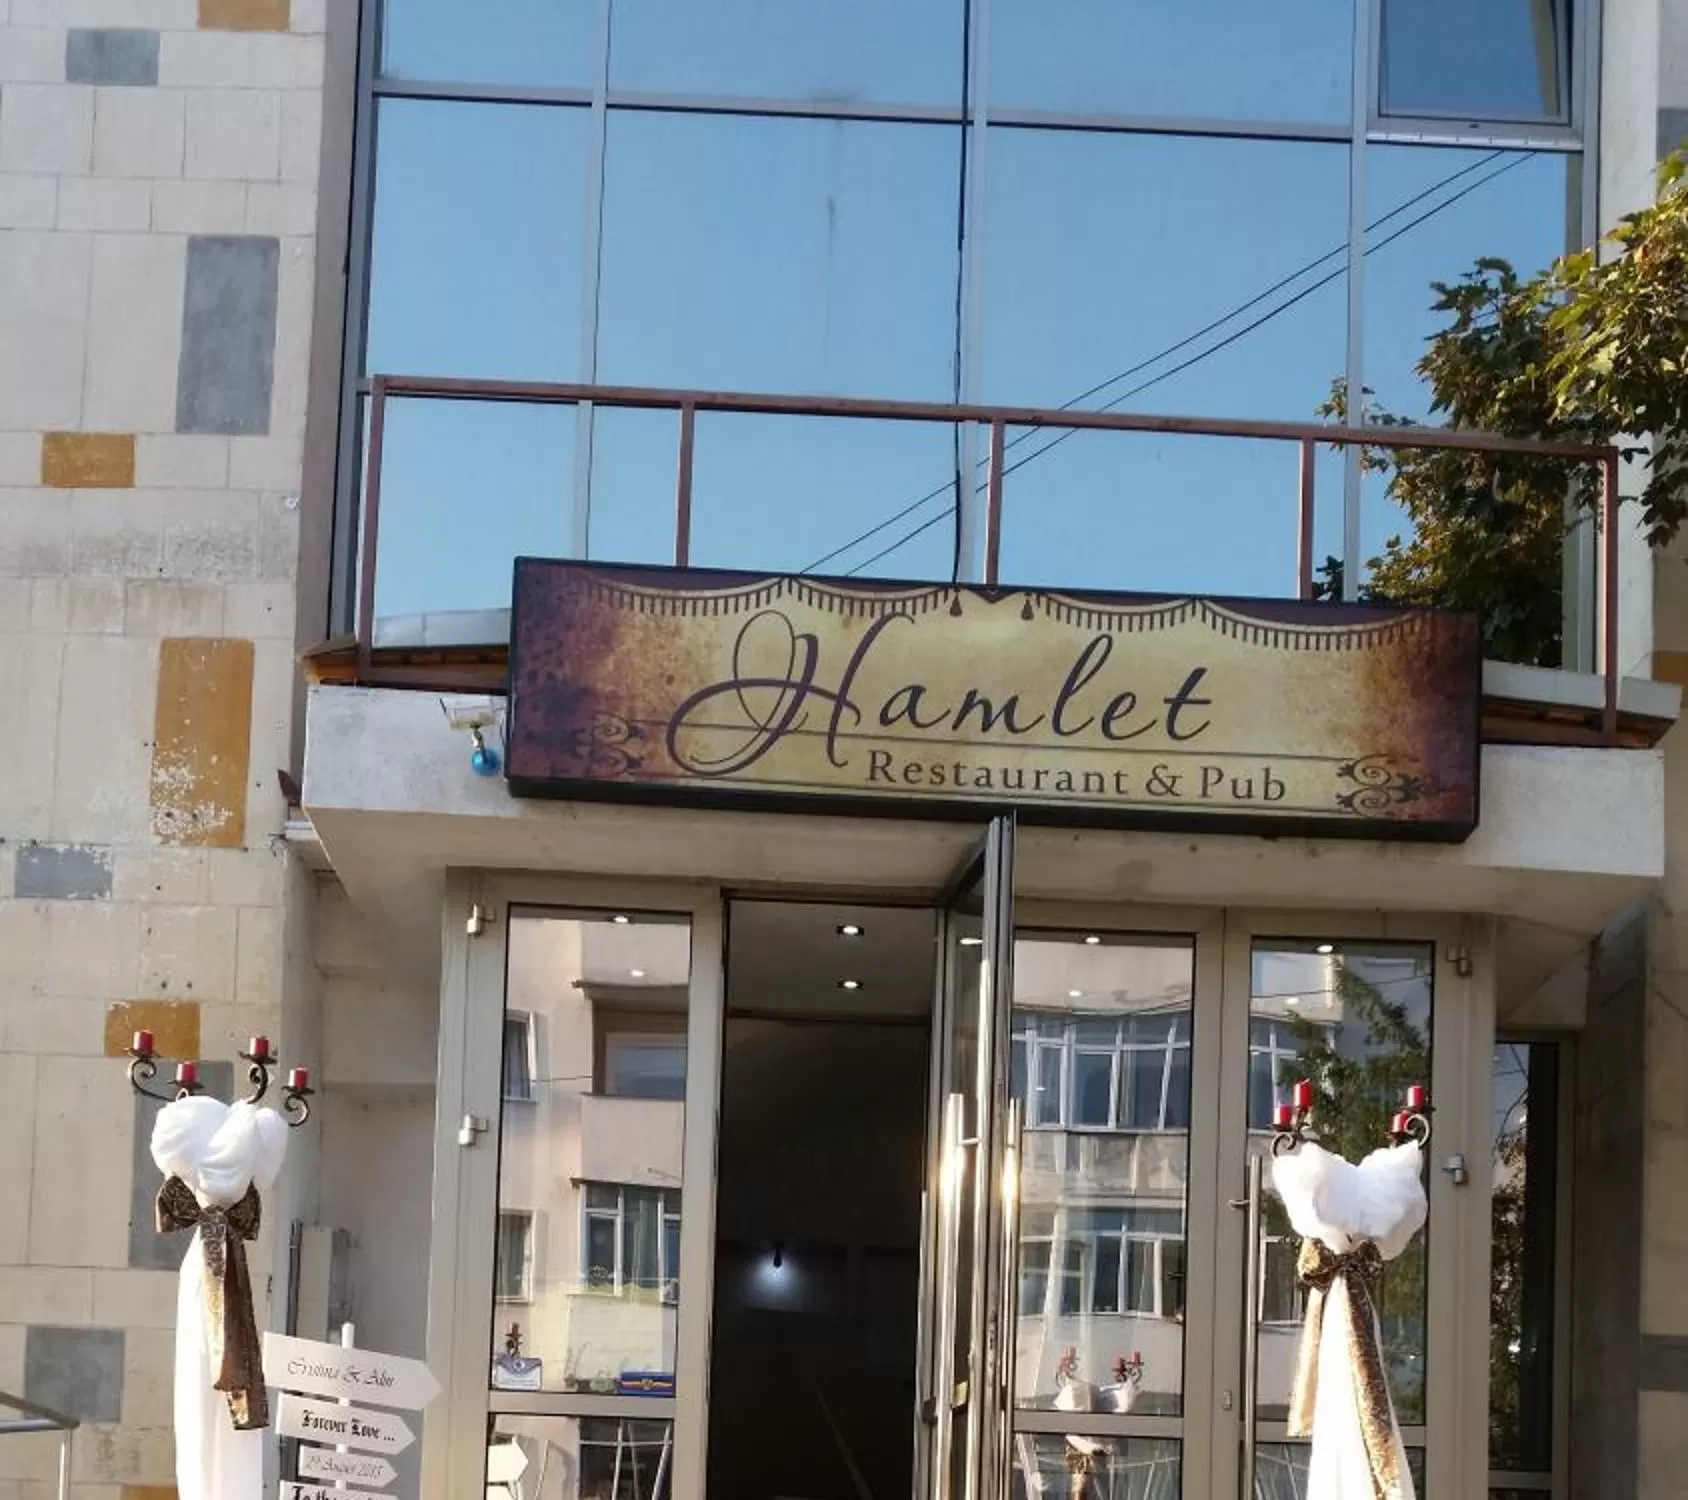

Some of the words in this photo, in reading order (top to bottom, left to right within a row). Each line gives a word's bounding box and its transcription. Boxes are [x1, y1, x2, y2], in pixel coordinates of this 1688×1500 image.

[667, 610, 1212, 776] Hamlet
[866, 749, 1128, 794] Restaurant
[1145, 763, 1184, 798] &
[1200, 765, 1287, 801] Pub
[302, 1409, 348, 1433] Forever
